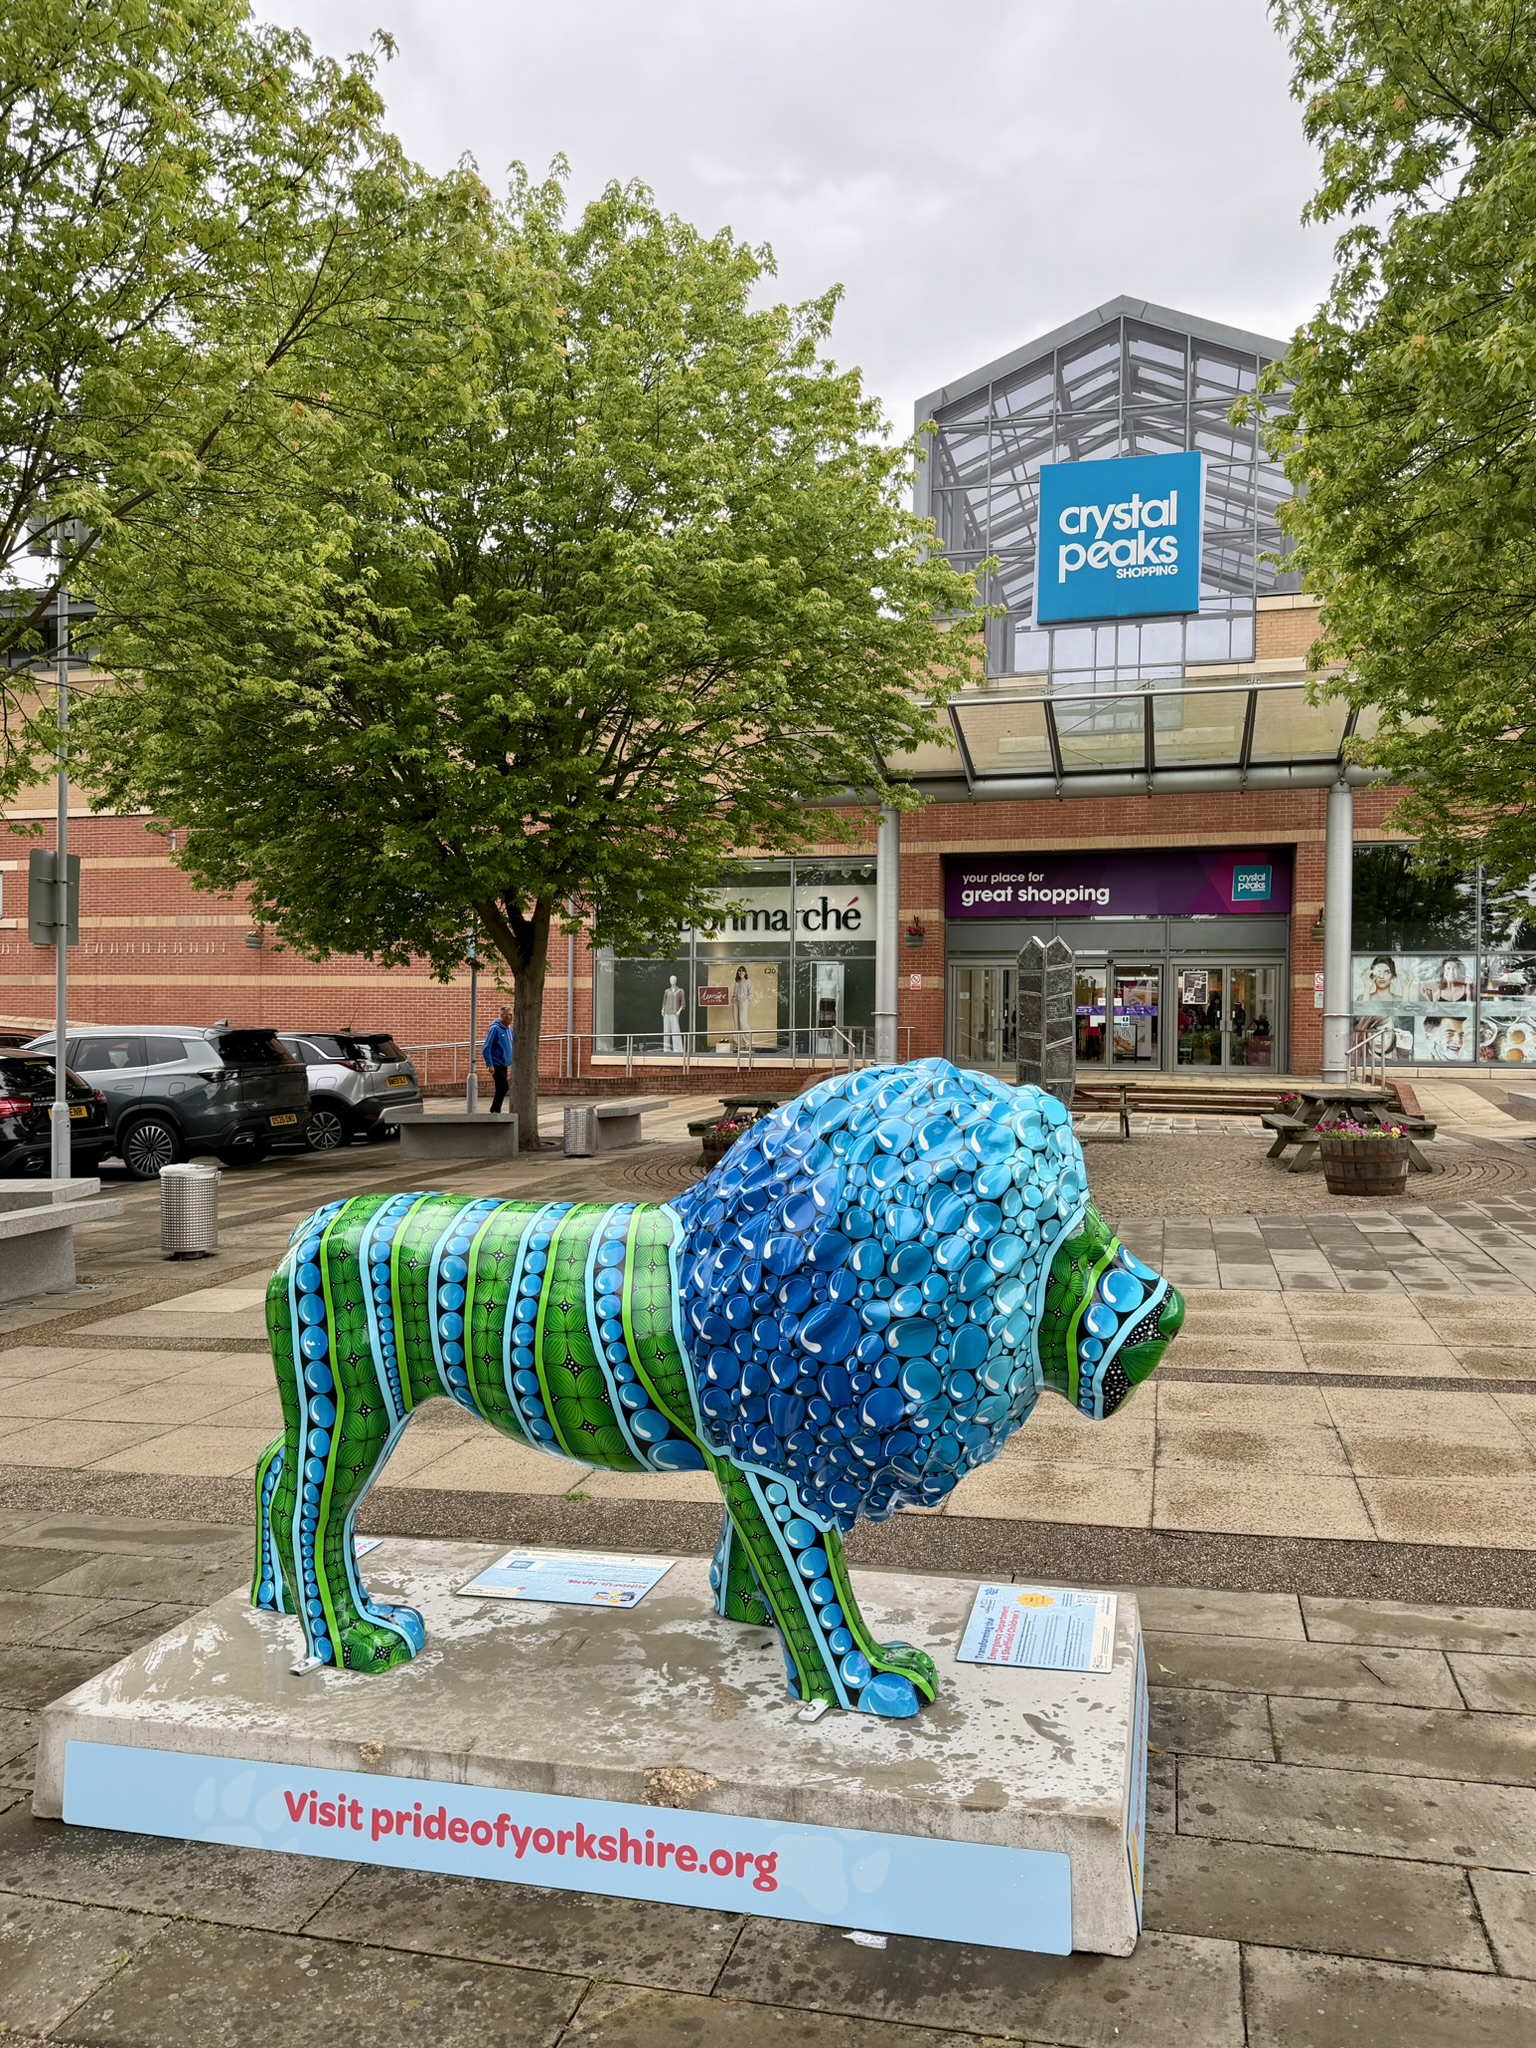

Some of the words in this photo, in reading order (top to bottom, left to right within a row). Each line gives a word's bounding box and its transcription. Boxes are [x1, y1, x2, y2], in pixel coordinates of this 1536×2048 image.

[1059, 490, 1178, 540] crystal
[1058, 530, 1179, 584] peaks
[1116, 564, 1179, 579] SHOPPING
[962, 874, 988, 885] your
[991, 872, 1025, 884] place
[1028, 871, 1045, 882] for
[1238, 881, 1266, 892] peaks
[961, 886, 1013, 907] great
[1018, 885, 1110, 905] shopping
[284, 1789, 364, 1831] Visit
[371, 1802, 779, 1892] prideofyorkshire.org
